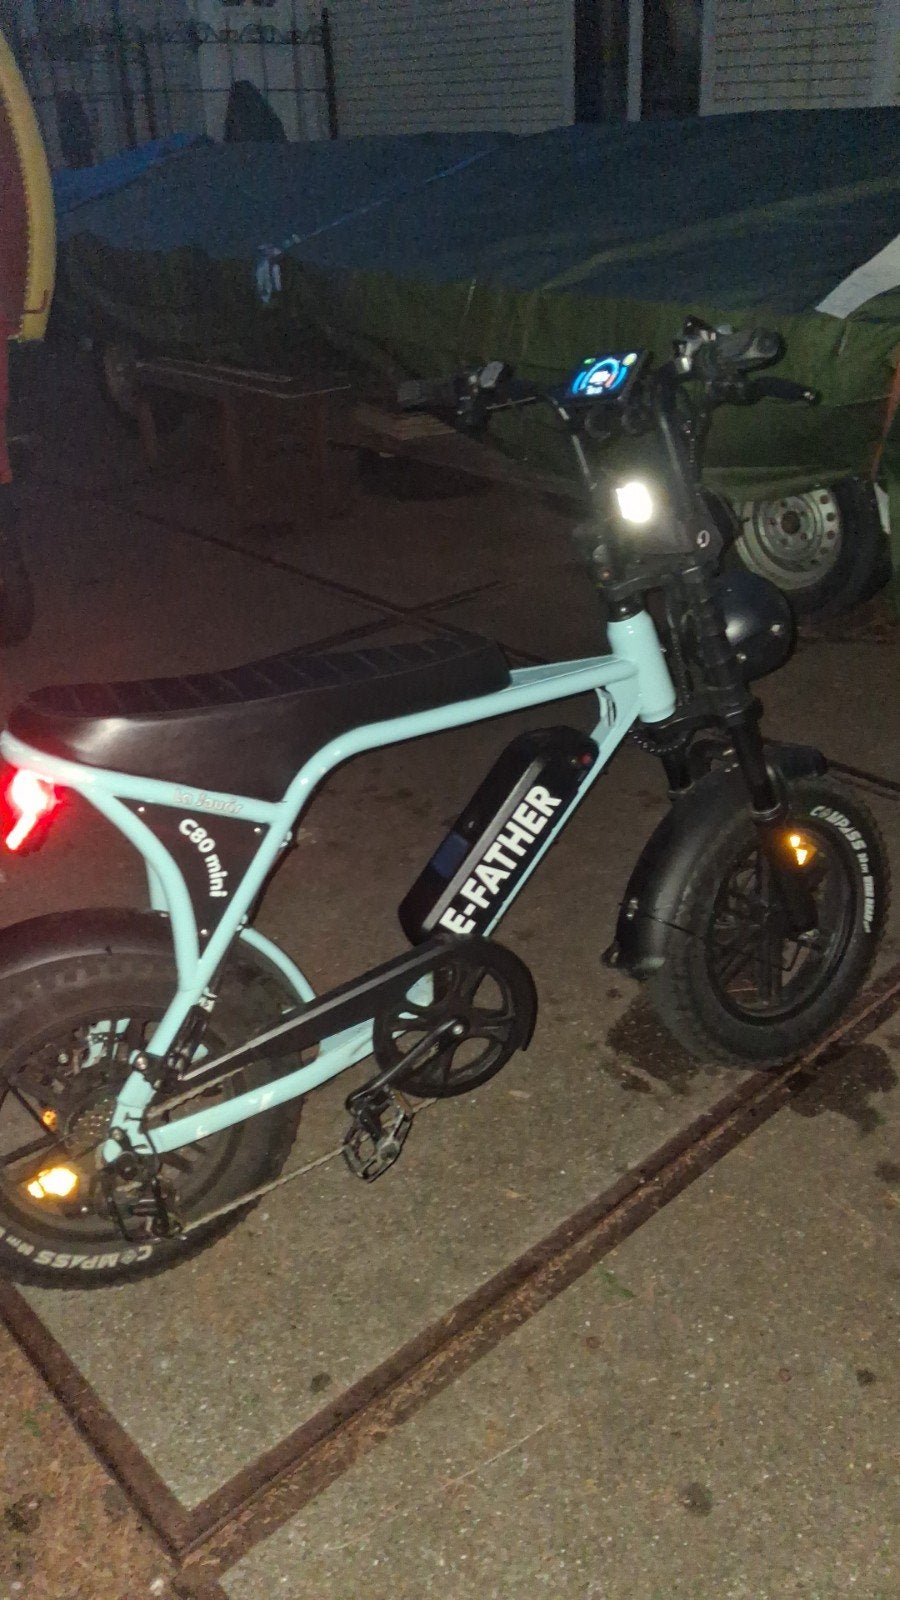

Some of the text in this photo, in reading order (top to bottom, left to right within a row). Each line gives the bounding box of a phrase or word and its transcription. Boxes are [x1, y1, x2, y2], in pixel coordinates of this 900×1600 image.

[178, 818, 228, 897] C80 mini
[810, 805, 867, 850] COMPASS
[438, 785, 562, 934] E-FATHER
[33, 1245, 153, 1269] COMPASS
